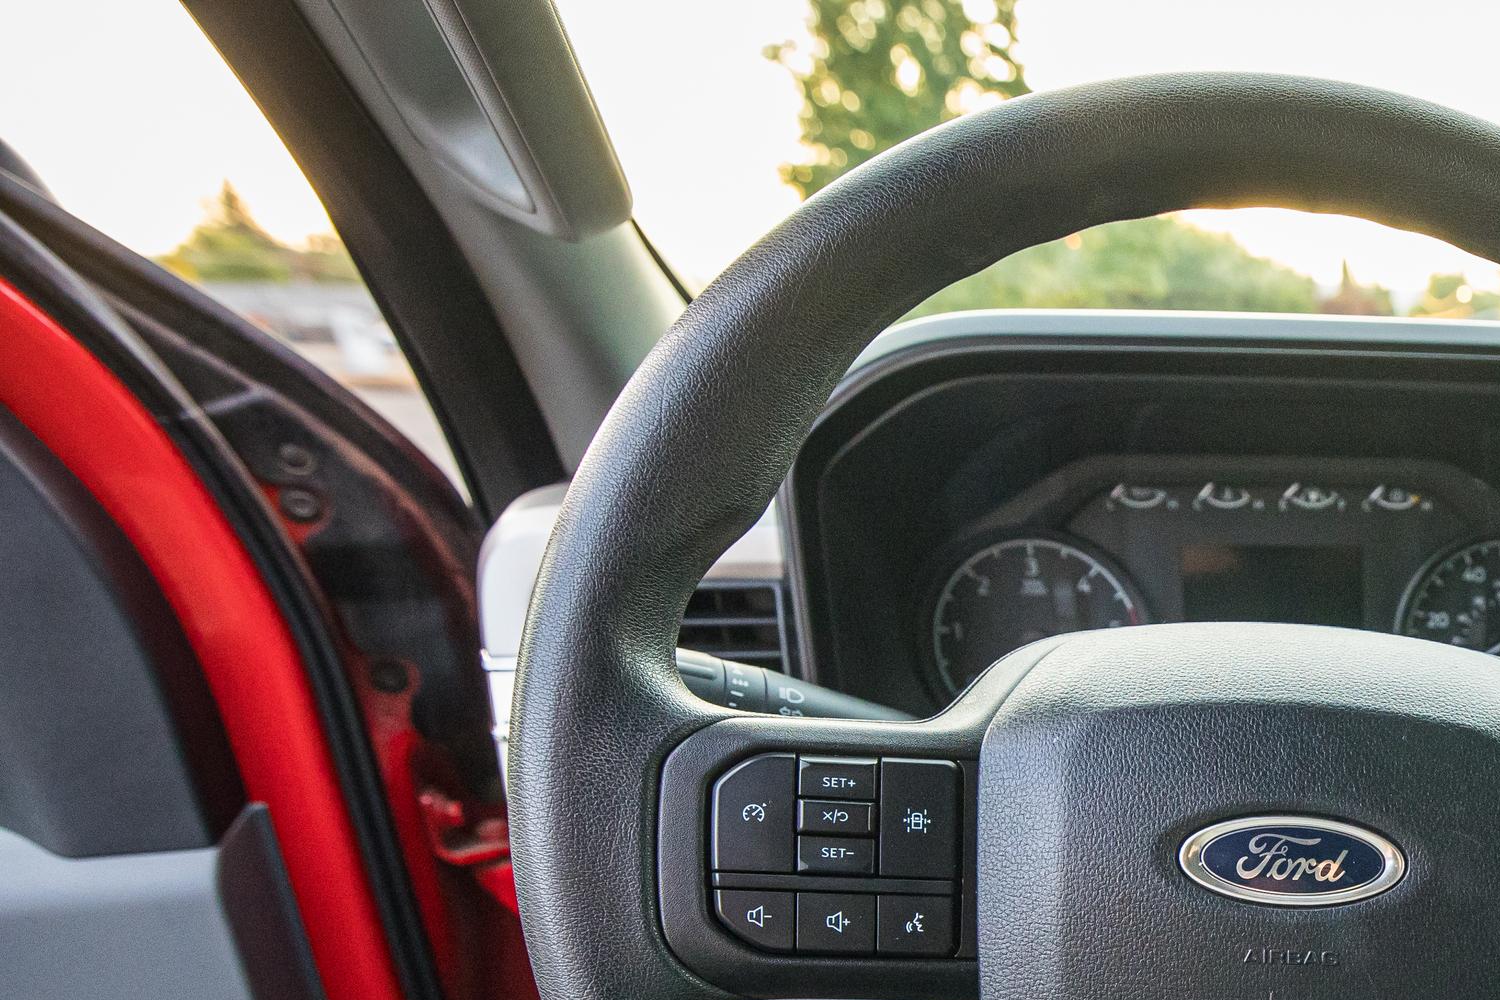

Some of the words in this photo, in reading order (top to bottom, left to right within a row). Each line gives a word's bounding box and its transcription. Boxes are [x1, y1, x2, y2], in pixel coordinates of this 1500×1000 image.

[822, 776, 856, 788] SET+
[1236, 833, 1349, 883] Ford
[1243, 948, 1340, 967] AIRBAG
